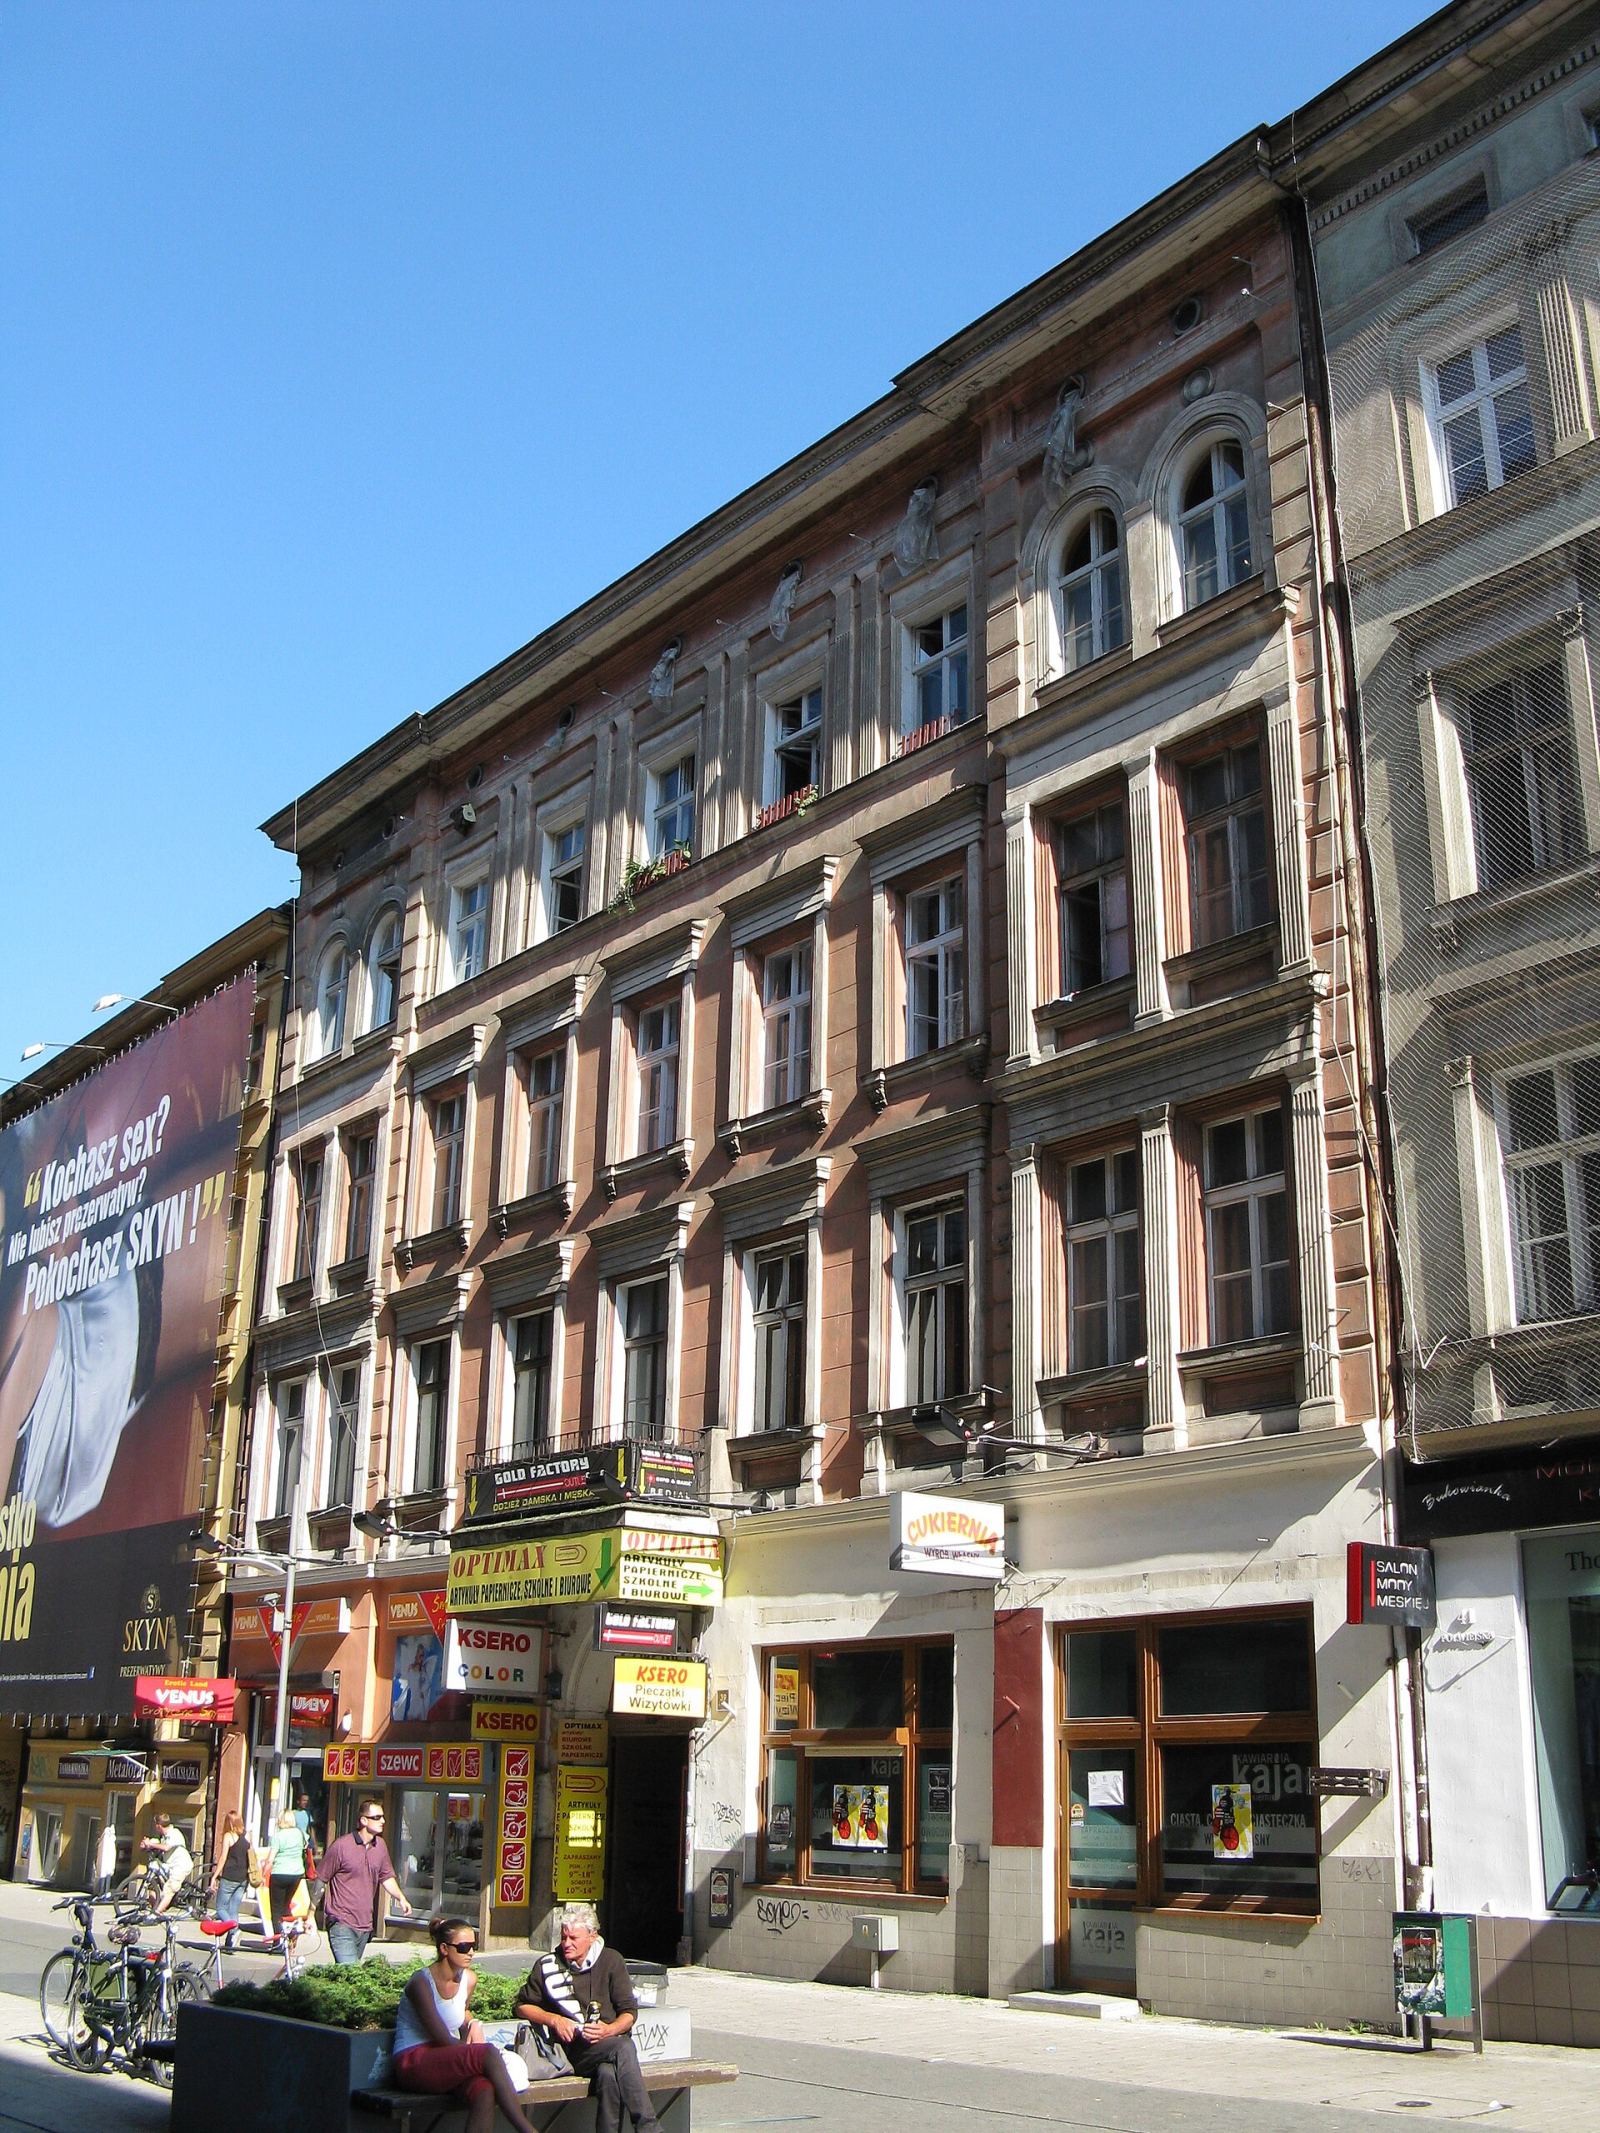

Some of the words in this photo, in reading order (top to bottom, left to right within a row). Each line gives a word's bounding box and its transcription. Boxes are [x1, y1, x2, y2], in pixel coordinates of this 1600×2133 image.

[119, 1094, 171, 1173] sex?
[7, 1229, 27, 1267] Nie
[28, 1215, 64, 1257] lubisz
[61, 1166, 148, 1244] prezerwatyw?
[22, 1230, 124, 1316] Pokochasz
[494, 1471, 526, 1485] GOLD
[564, 1475, 587, 1487] OUTLE
[522, 1494, 557, 1507] DAMSKA
[907, 1511, 998, 1556] CUKIERNIA
[627, 1531, 720, 1560] OPTIMAX
[453, 1544, 547, 1578] OPTIMAX
[1376, 1560, 1417, 1575] SALON
[450, 1585, 480, 1606] ARTYKUŁY
[480, 1581, 522, 1603] PAPIERNICZE,
[524, 1577, 552, 1599] SZKOLNE
[554, 1577, 558, 1596] I
[560, 1573, 592, 1596] BIUROWE
[624, 1576, 677, 1589] SZKOLNE
[622, 1588, 626, 1596] I
[631, 1589, 688, 1602] BIUROWE
[391, 1602, 418, 1618] VENUS
[1456, 1607, 1476, 1625] 41
[235, 1614, 258, 1630] VENUS
[605, 1612, 631, 1627] GOLD
[123, 1617, 170, 1653] SKYN
[457, 1628, 531, 1653] KSERO
[120, 1664, 166, 1677] PREZERWATYWY
[458, 1663, 524, 1682] COLOR
[636, 1665, 688, 1684] KSERO
[164, 1679, 187, 1687] Erotic
[190, 1680, 208, 1688] Land
[635, 1684, 685, 1698] Pieczątki
[155, 1688, 214, 1705] VENUS
[629, 1696, 691, 1712] Wizytówki
[476, 1711, 538, 1731] KSERO
[564, 1722, 603, 1730] OPTIMAX
[380, 1754, 420, 1771] szewc
[871, 1755, 901, 1777] kaja
[1232, 1754, 1304, 1801] kaja
